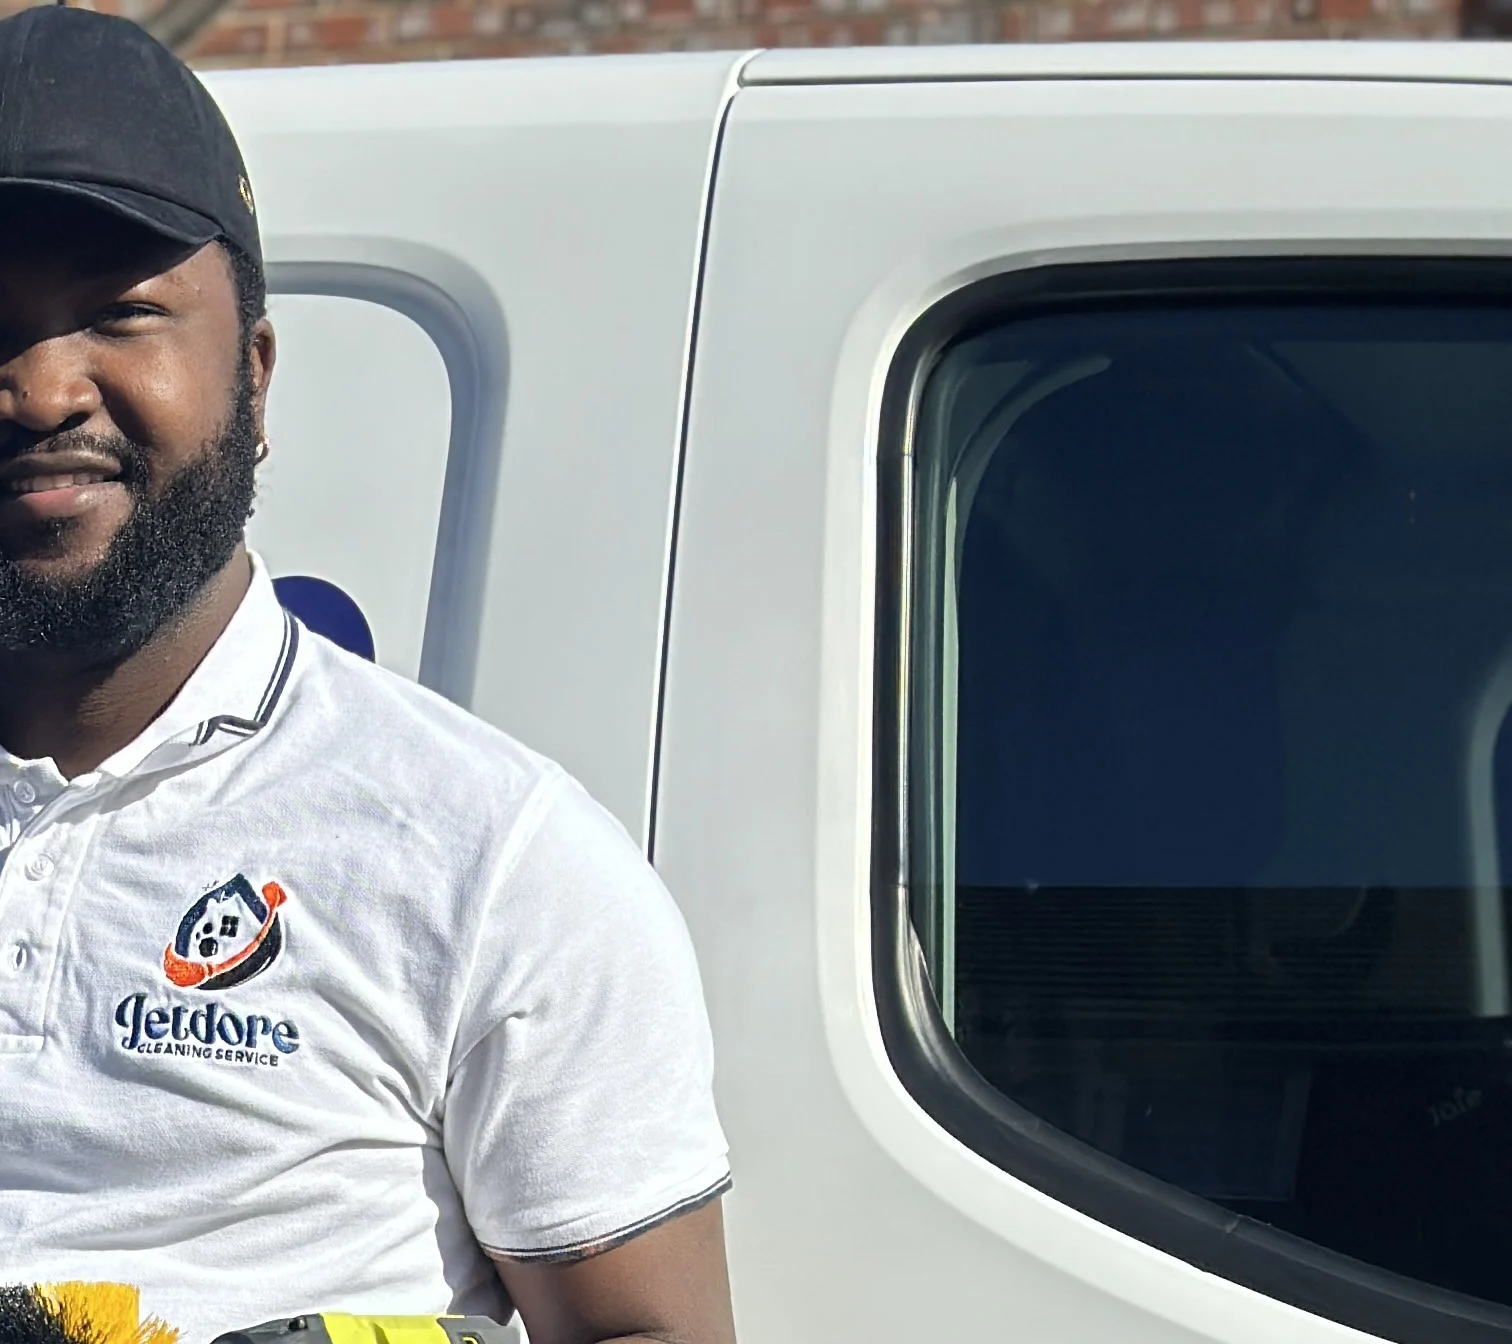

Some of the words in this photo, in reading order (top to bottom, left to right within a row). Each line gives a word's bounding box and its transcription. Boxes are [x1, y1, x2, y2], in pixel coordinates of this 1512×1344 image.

[115, 992, 300, 1054] Jetdore
[136, 1042, 212, 1060] CLEANING
[215, 1048, 279, 1067] SERVICE
